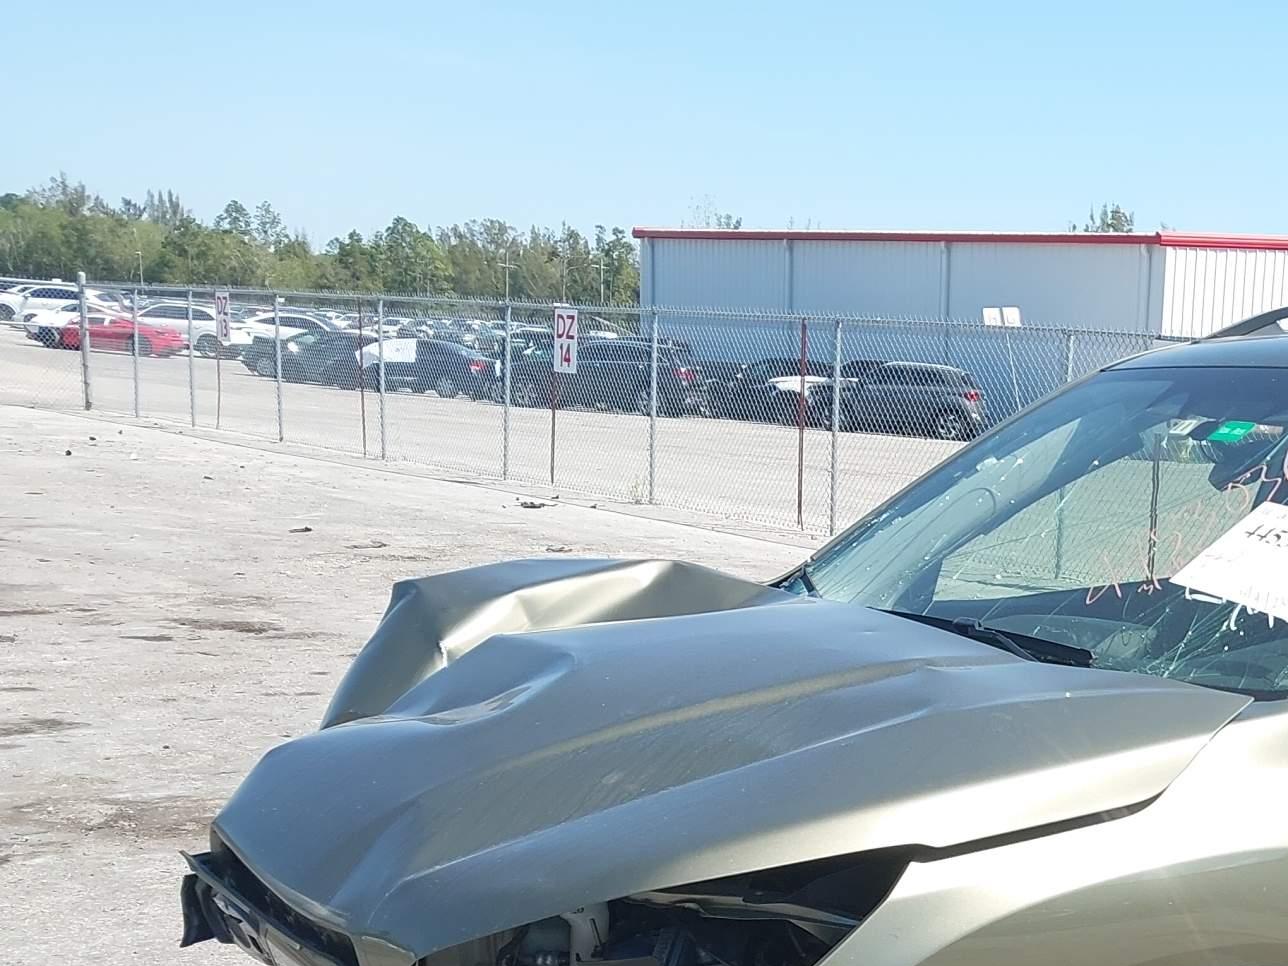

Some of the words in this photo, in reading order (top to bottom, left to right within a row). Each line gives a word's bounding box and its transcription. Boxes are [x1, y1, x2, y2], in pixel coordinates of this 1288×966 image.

[217, 296, 228, 316] DZ
[220, 319, 228, 337] 13
[557, 314, 575, 339] DZ
[560, 343, 571, 367] 14
